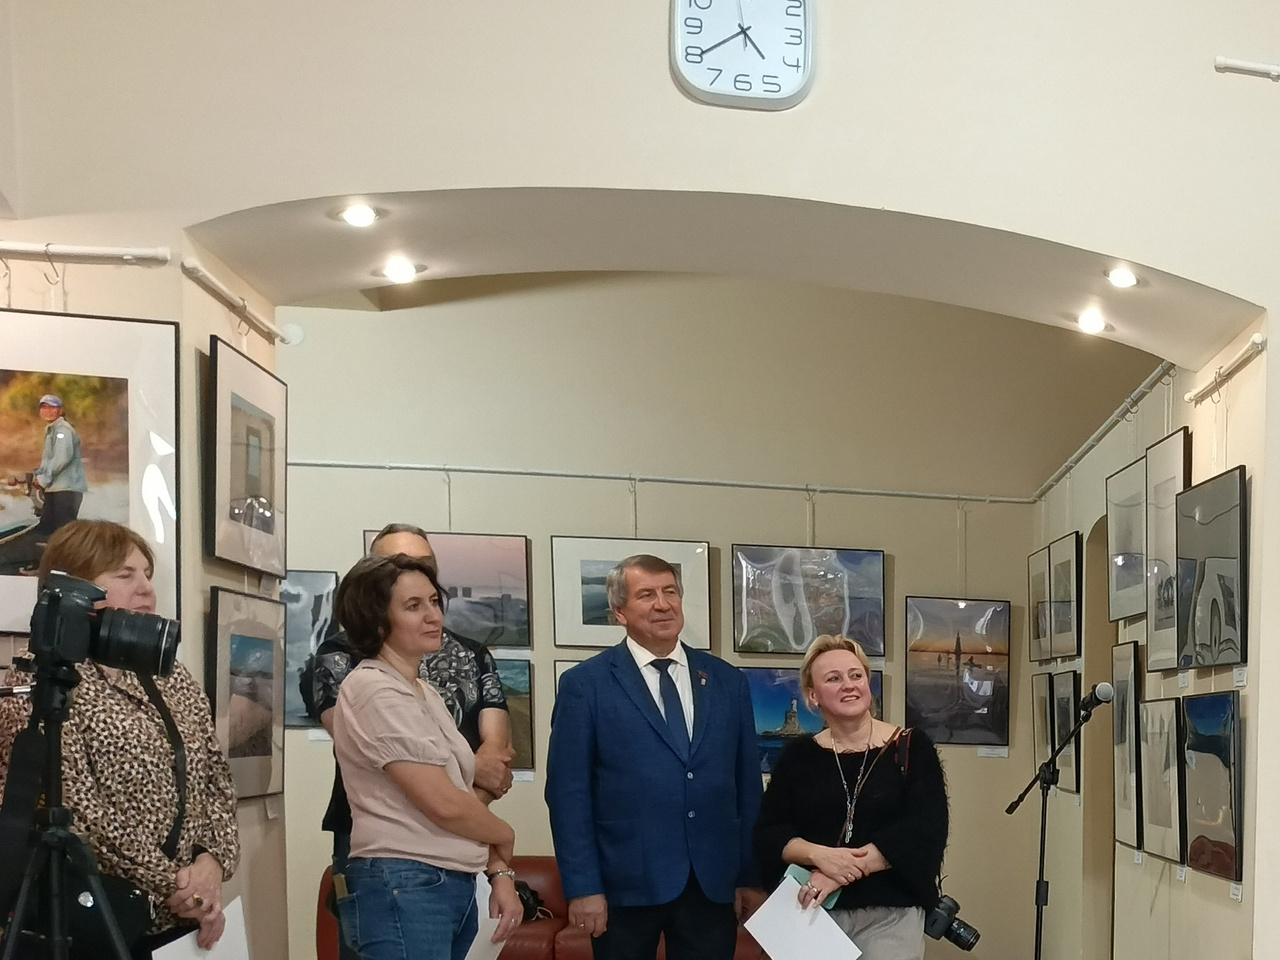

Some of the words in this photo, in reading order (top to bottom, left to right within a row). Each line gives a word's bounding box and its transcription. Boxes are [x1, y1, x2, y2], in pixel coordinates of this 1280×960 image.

[785, 0, 803, 17] 2
[684, 17, 703, 35] 9
[784, 27, 803, 46] 3
[684, 45, 704, 64] 8
[782, 55, 802, 74] 4
[706, 67, 723, 86] 7
[733, 74, 752, 91] 6
[762, 75, 782, 93] 5
